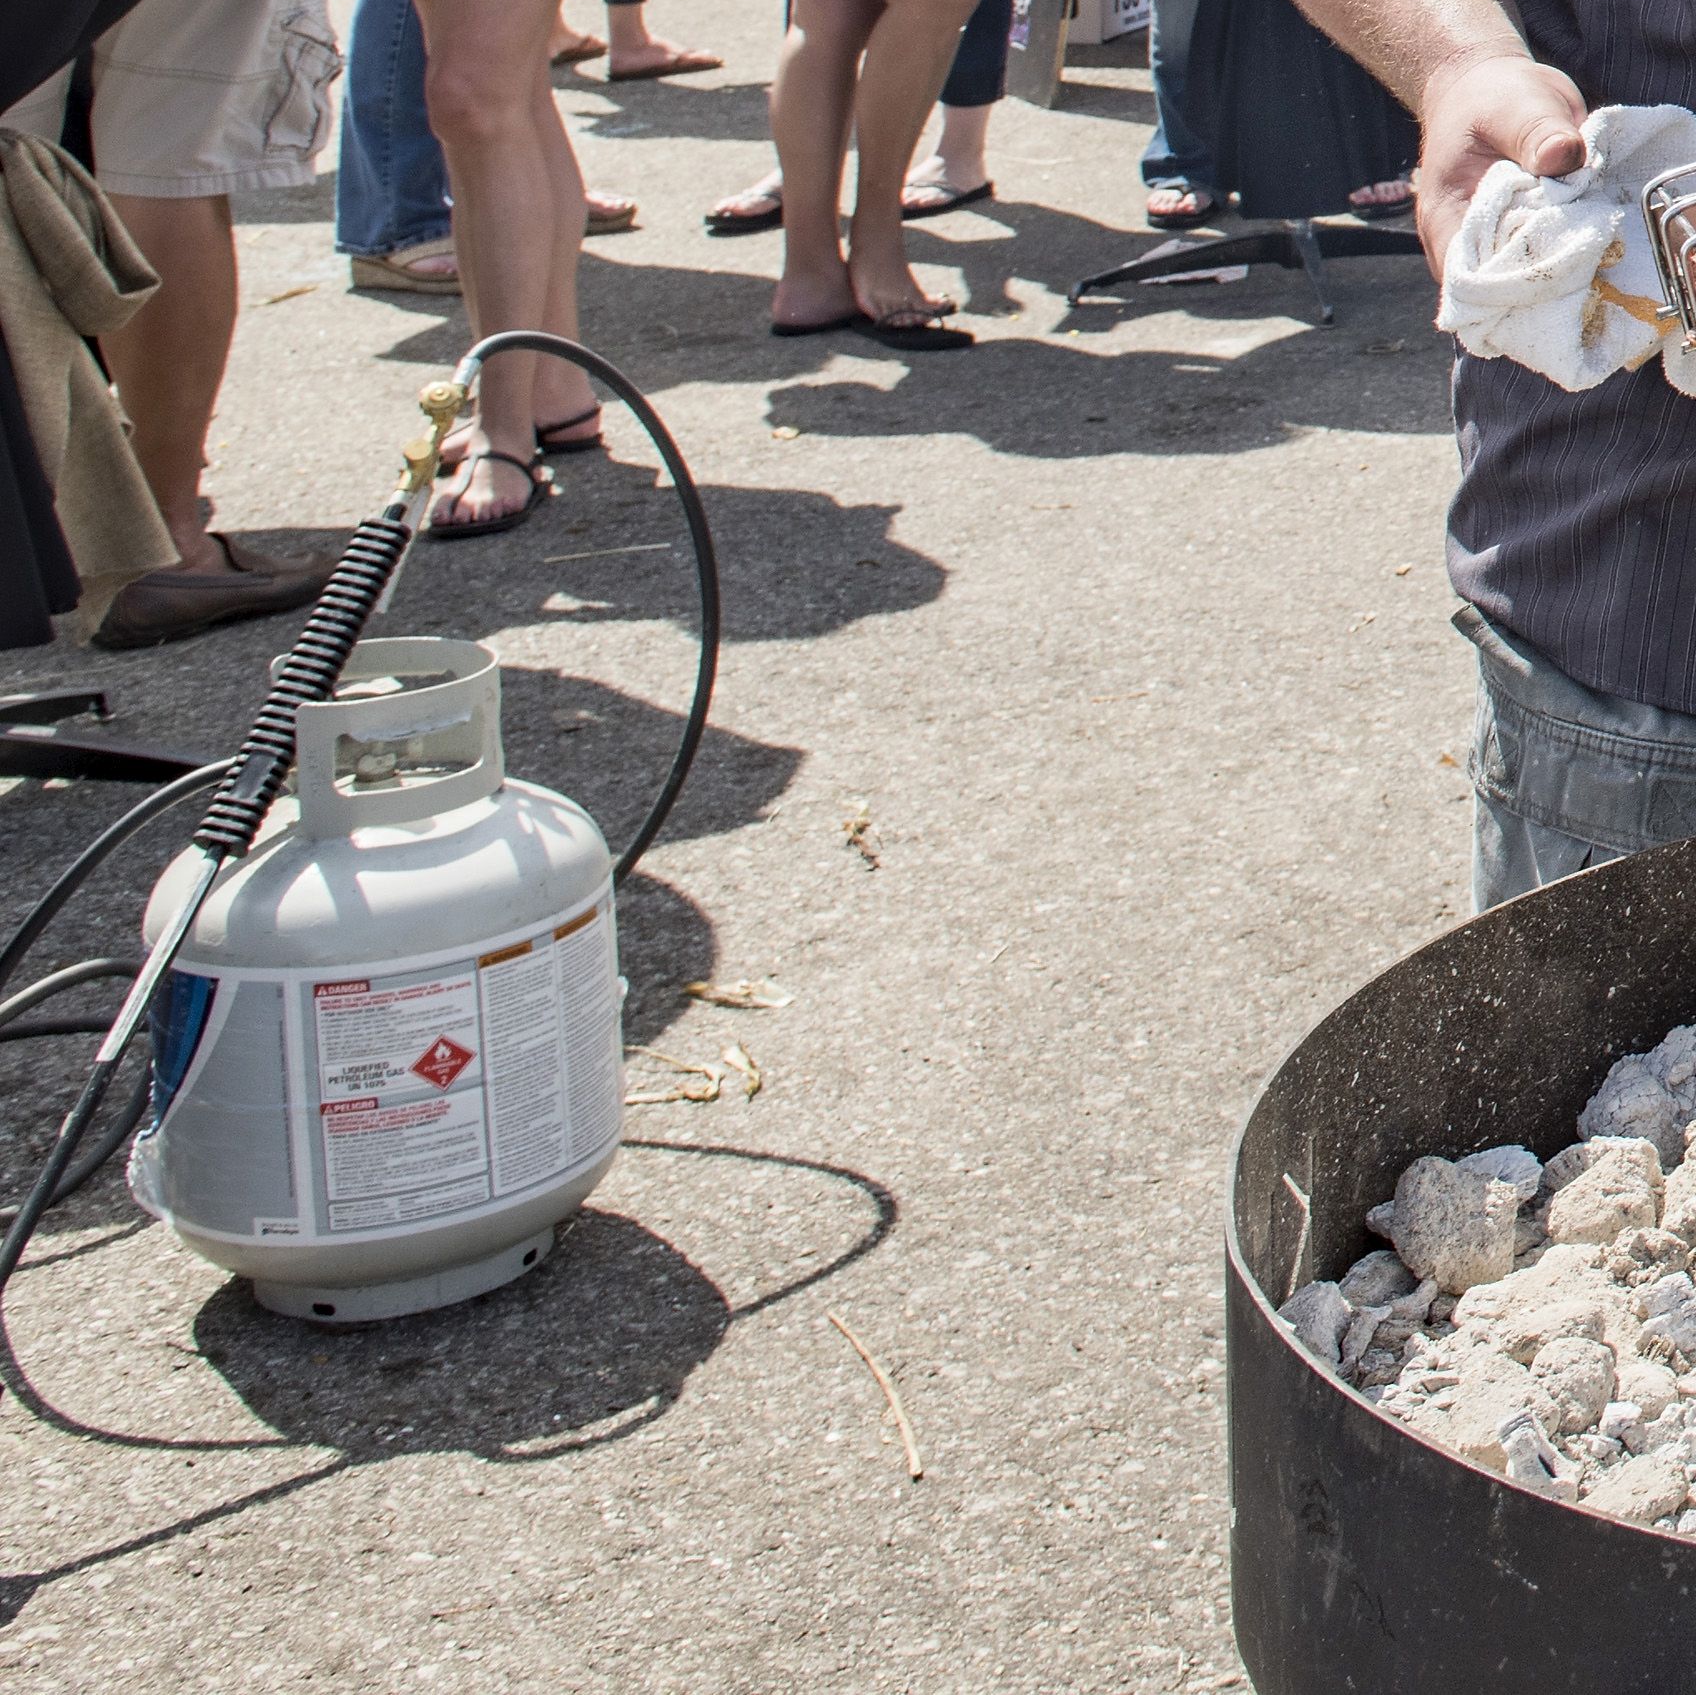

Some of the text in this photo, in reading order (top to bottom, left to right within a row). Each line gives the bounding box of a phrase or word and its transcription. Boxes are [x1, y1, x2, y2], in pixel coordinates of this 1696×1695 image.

[327, 981, 369, 996] DANGER
[386, 1067, 405, 1078] GAS
[333, 1099, 377, 1113] PELIGRO
